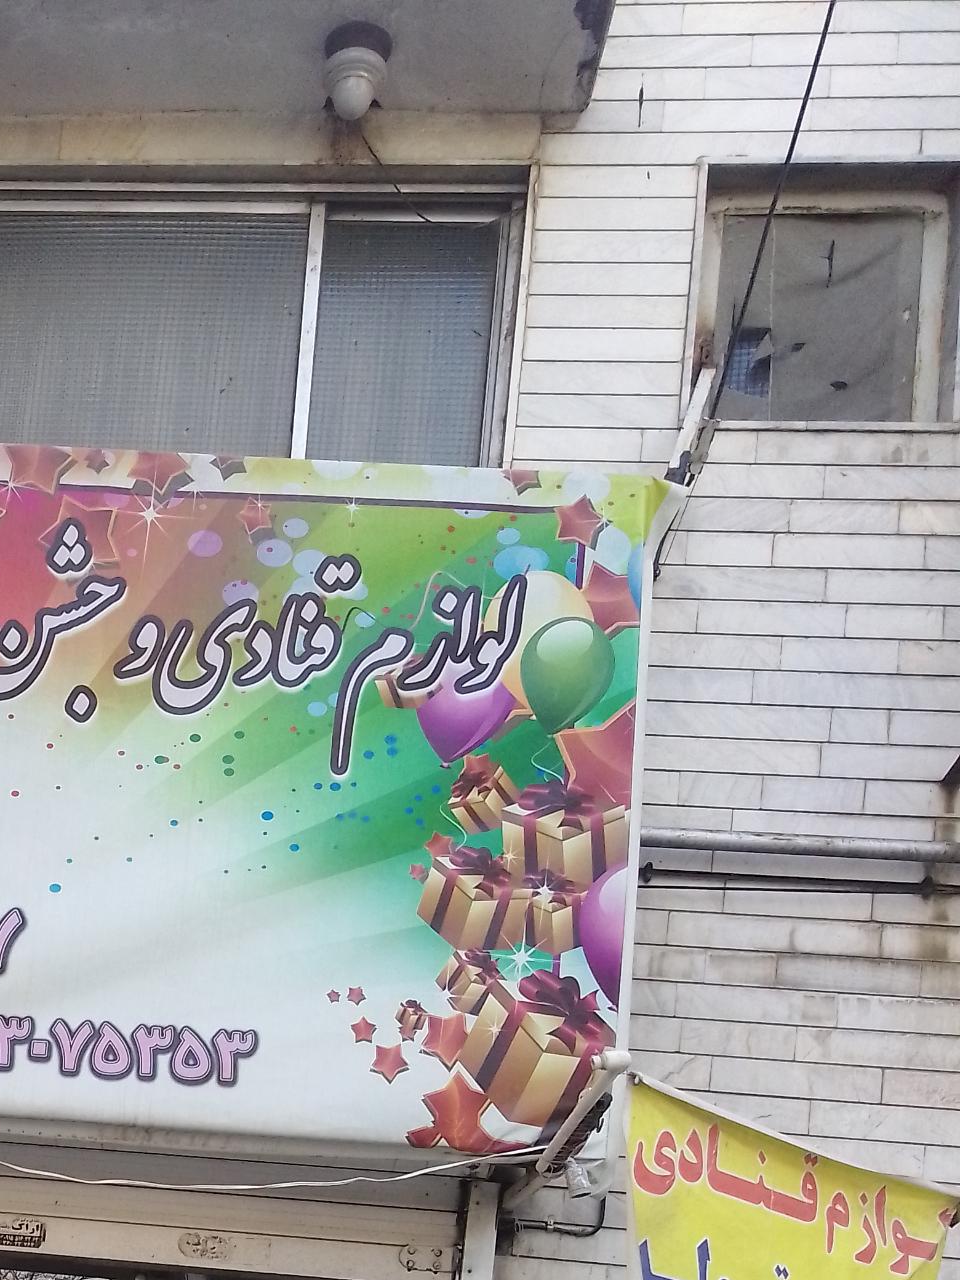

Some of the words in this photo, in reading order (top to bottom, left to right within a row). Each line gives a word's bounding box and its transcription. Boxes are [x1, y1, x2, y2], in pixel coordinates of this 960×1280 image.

[114, 617, 158, 679] و
[150, 555, 359, 714] قنادی
[332, 574, 527, 775] لوازم
[633, 1122, 818, 1223] قنادی
